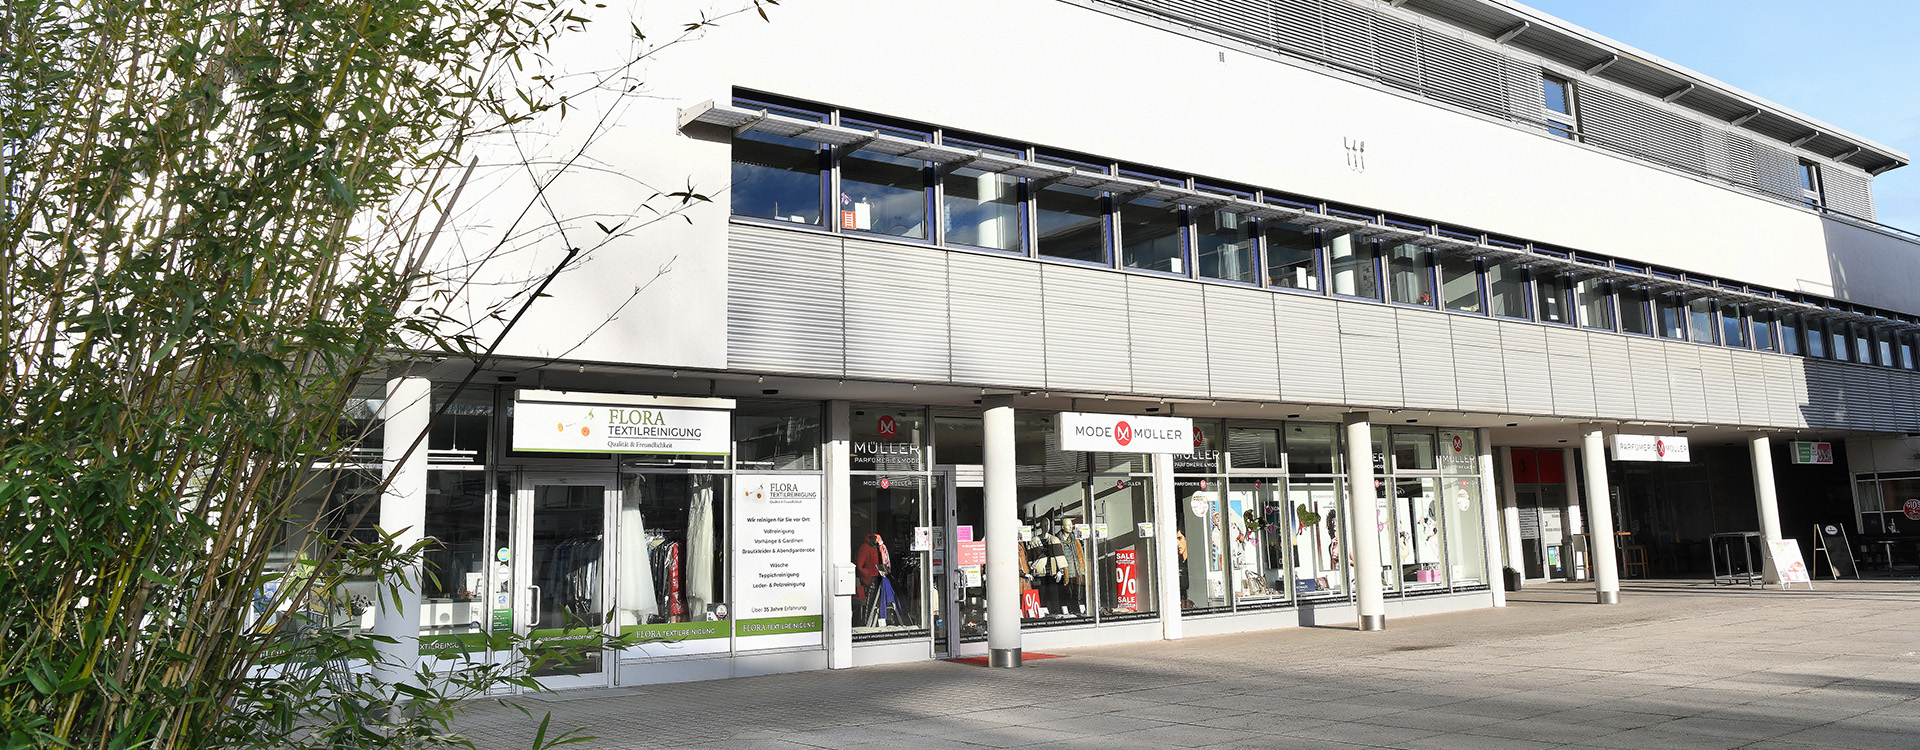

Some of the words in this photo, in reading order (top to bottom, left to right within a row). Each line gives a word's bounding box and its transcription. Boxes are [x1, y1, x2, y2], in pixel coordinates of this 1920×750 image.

[609, 409, 666, 426] FLORA
[608, 426, 702, 437] TEXTILREINIGUNG
[1075, 426, 1112, 438] MODE
[1134, 428, 1182, 440] MÜLLER
[636, 441, 673, 449] Freundlichkeit
[854, 441, 920, 455] MÜLLER
[770, 483, 798, 492] FLORA
[1116, 552, 1135, 560] SALE
[1116, 565, 1136, 596] %
[743, 624, 766, 632] FLORA
[767, 622, 816, 630] TEXTILREINIGUNG
[636, 630, 661, 638] FLORA
[662, 628, 716, 637] TEXTILREINIGUNG
